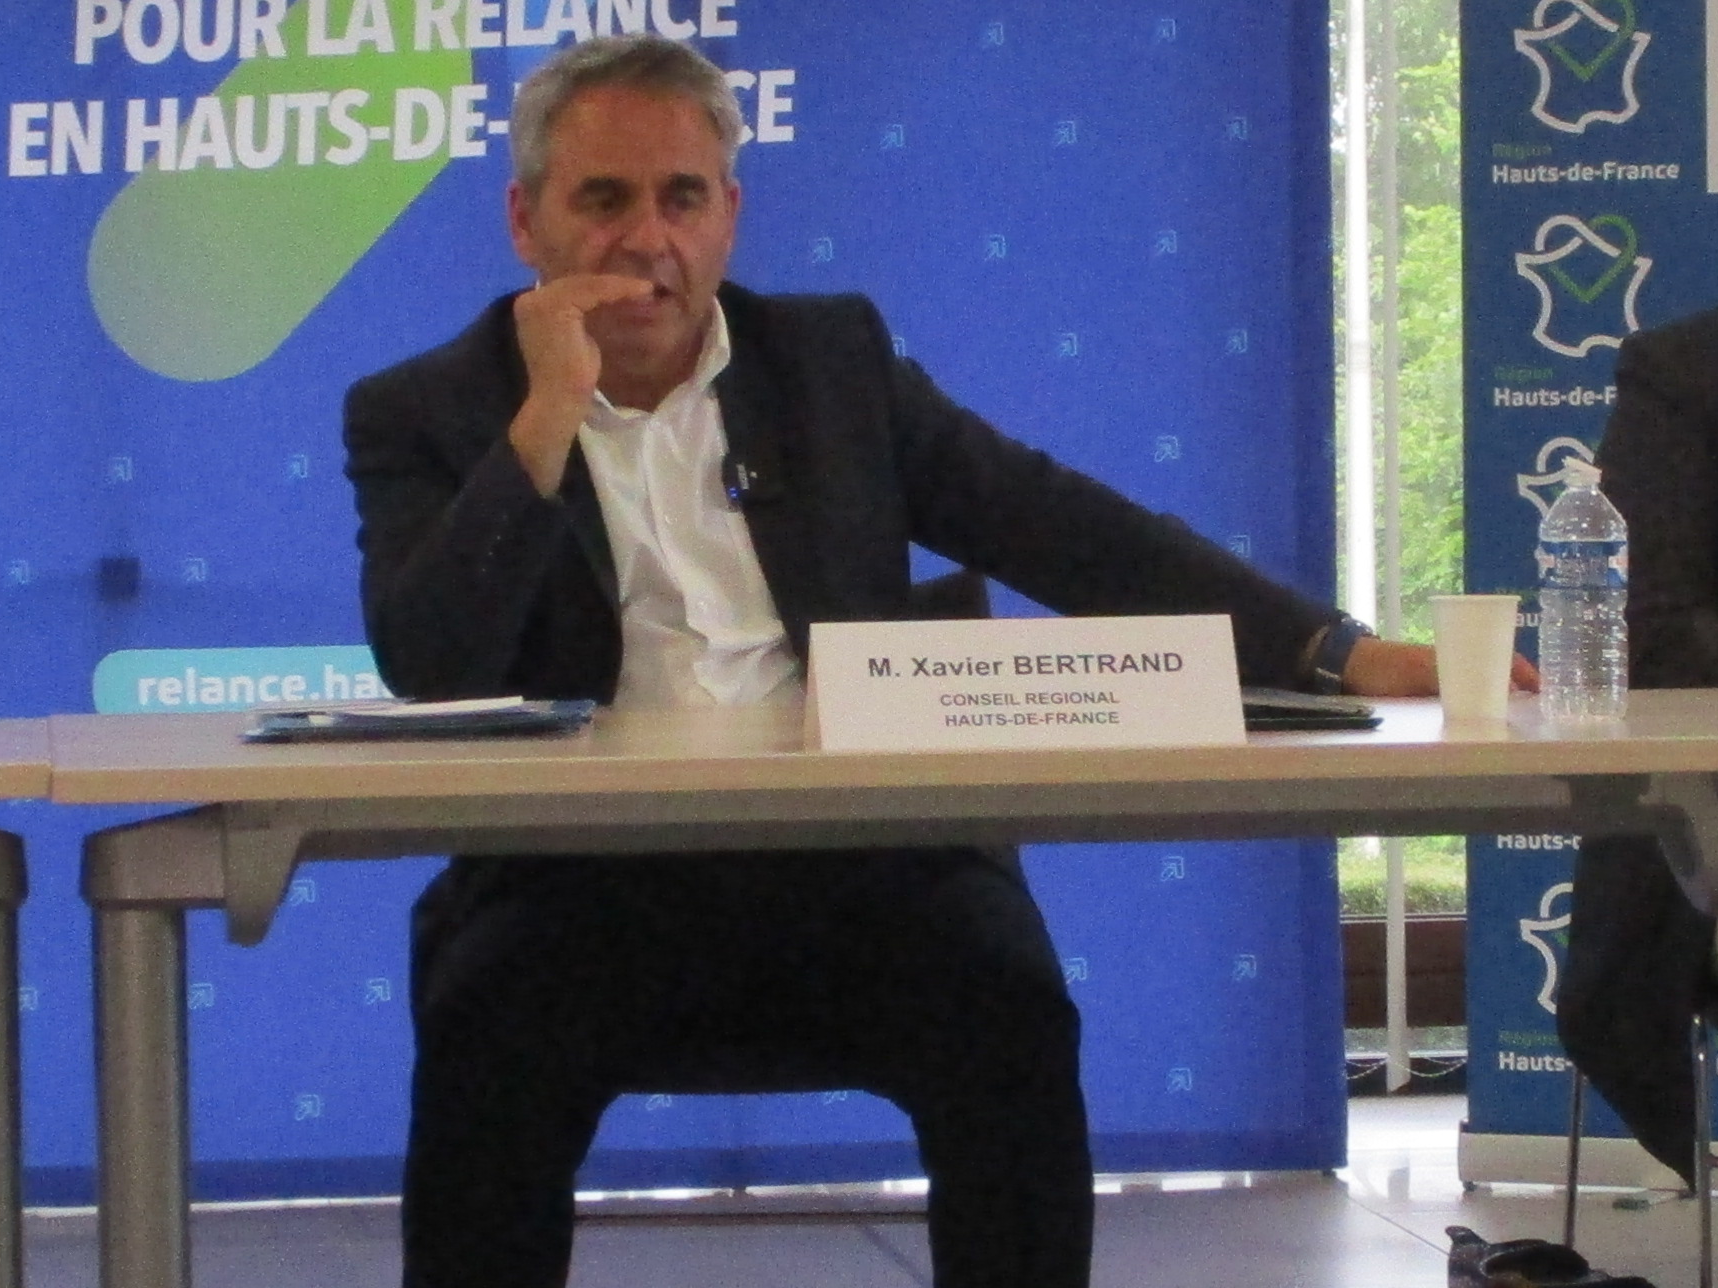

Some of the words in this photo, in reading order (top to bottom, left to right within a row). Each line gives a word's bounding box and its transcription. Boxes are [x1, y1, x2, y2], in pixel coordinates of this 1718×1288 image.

[8, 102, 103, 177] EN
[124, 70, 797, 172] HAUTS-DE-E
[1492, 161, 1681, 185] Hauts-de-France
[1493, 385, 1619, 407] Hauts-de-F
[868, 657, 902, 677] M.
[912, 654, 1003, 677] Xavier
[1014, 652, 1184, 675] BERTRAND
[137, 664, 389, 706] relance.ha
[939, 692, 1020, 707] CONSEIL
[1025, 690, 1121, 705] REGIONAL
[944, 711, 1120, 728] HAUTS-DE-FRANCE
